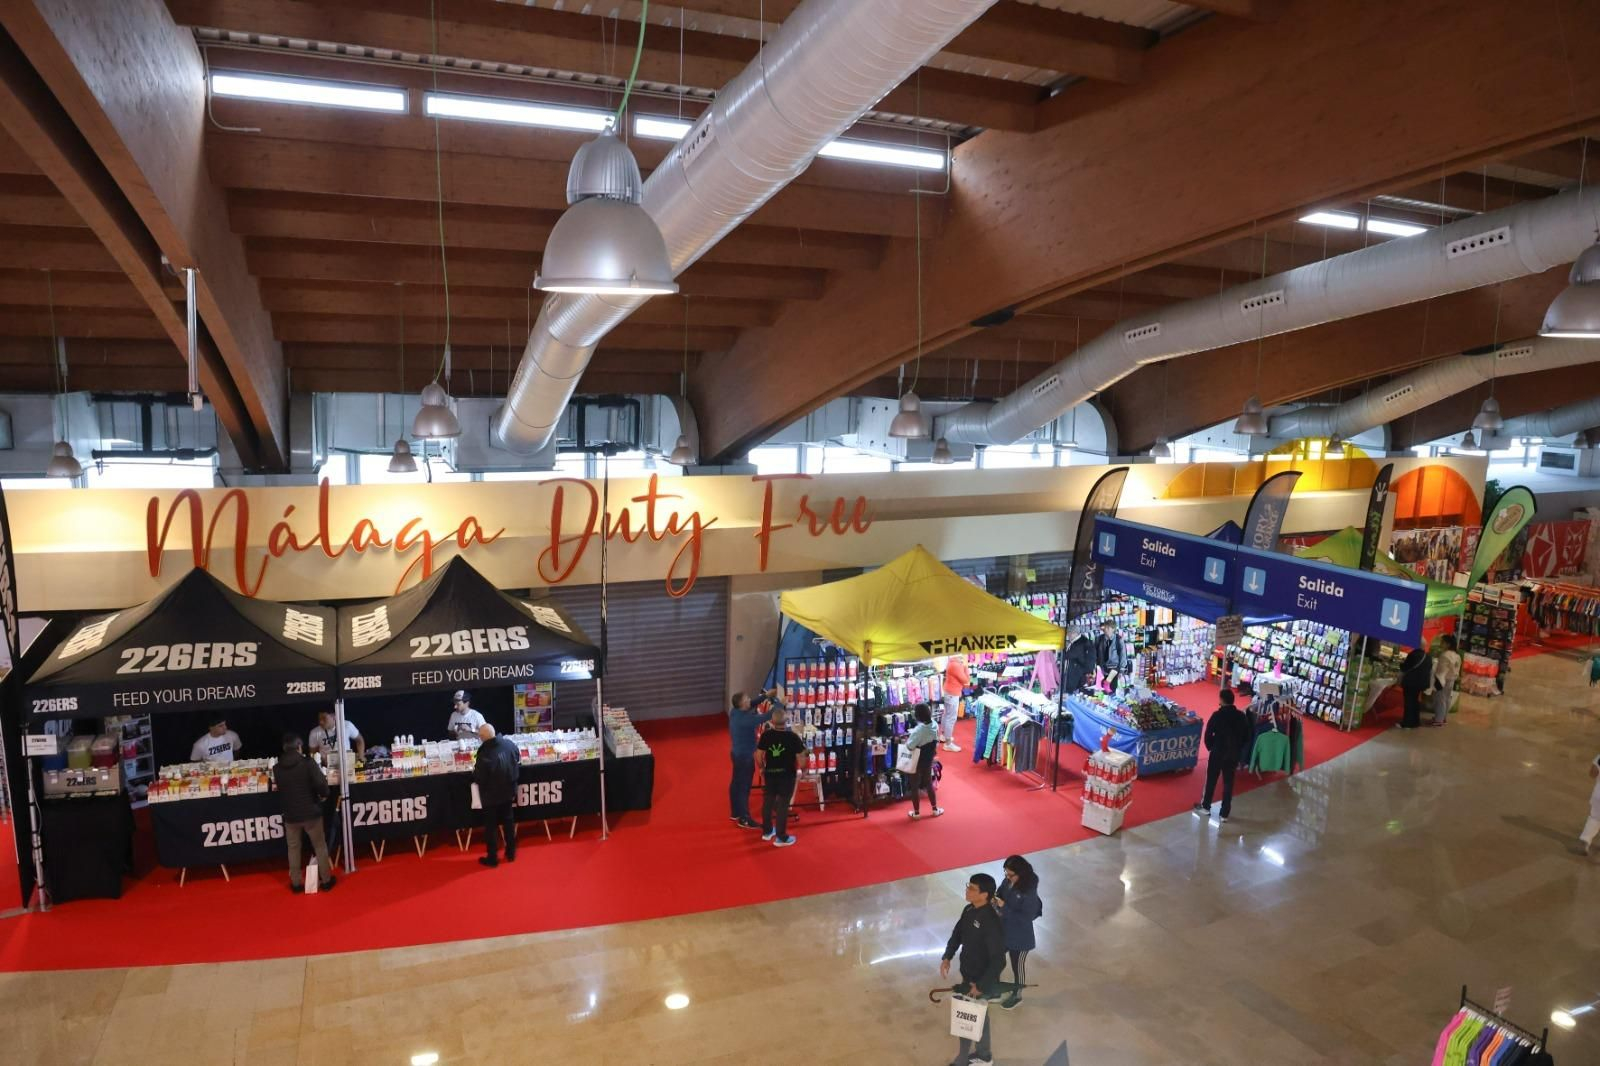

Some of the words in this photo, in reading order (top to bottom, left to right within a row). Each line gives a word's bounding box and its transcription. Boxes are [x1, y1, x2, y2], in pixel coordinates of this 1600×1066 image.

[146, 476, 508, 598] Málaga
[537, 472, 718, 598] Duty
[752, 472, 875, 572] Free
[1141, 537, 1176, 558] Salida
[1140, 552, 1157, 569] Exit
[1299, 575, 1344, 598] Salida
[1297, 592, 1318, 611] Exit
[409, 625, 530, 659] 226ERS
[945, 635, 1017, 653] HANKER
[116, 642, 258, 675] 226ERS
[561, 659, 595, 674] 226ERS
[344, 675, 382, 690] 226ERS
[412, 672, 443, 685] FEED
[446, 667, 480, 682] YOUR
[483, 664, 534, 680] DREAMS
[113, 691, 150, 707] FEED
[152, 688, 193, 704] YOUR
[197, 685, 256, 701] DREAMS
[286, 681, 326, 695] 226ERS
[33, 697, 78, 713] 226ERS
[208, 742, 232, 756] 226ERS
[1136, 735, 1198, 755] VICTORY
[1143, 748, 1198, 765] ENDURANC
[66, 776, 97, 787] 22ERS
[512, 780, 563, 807] 6ERS
[353, 796, 428, 827] 226ERS
[201, 814, 285, 847] 226ERS
[956, 1010, 977, 1022] 226ERS
